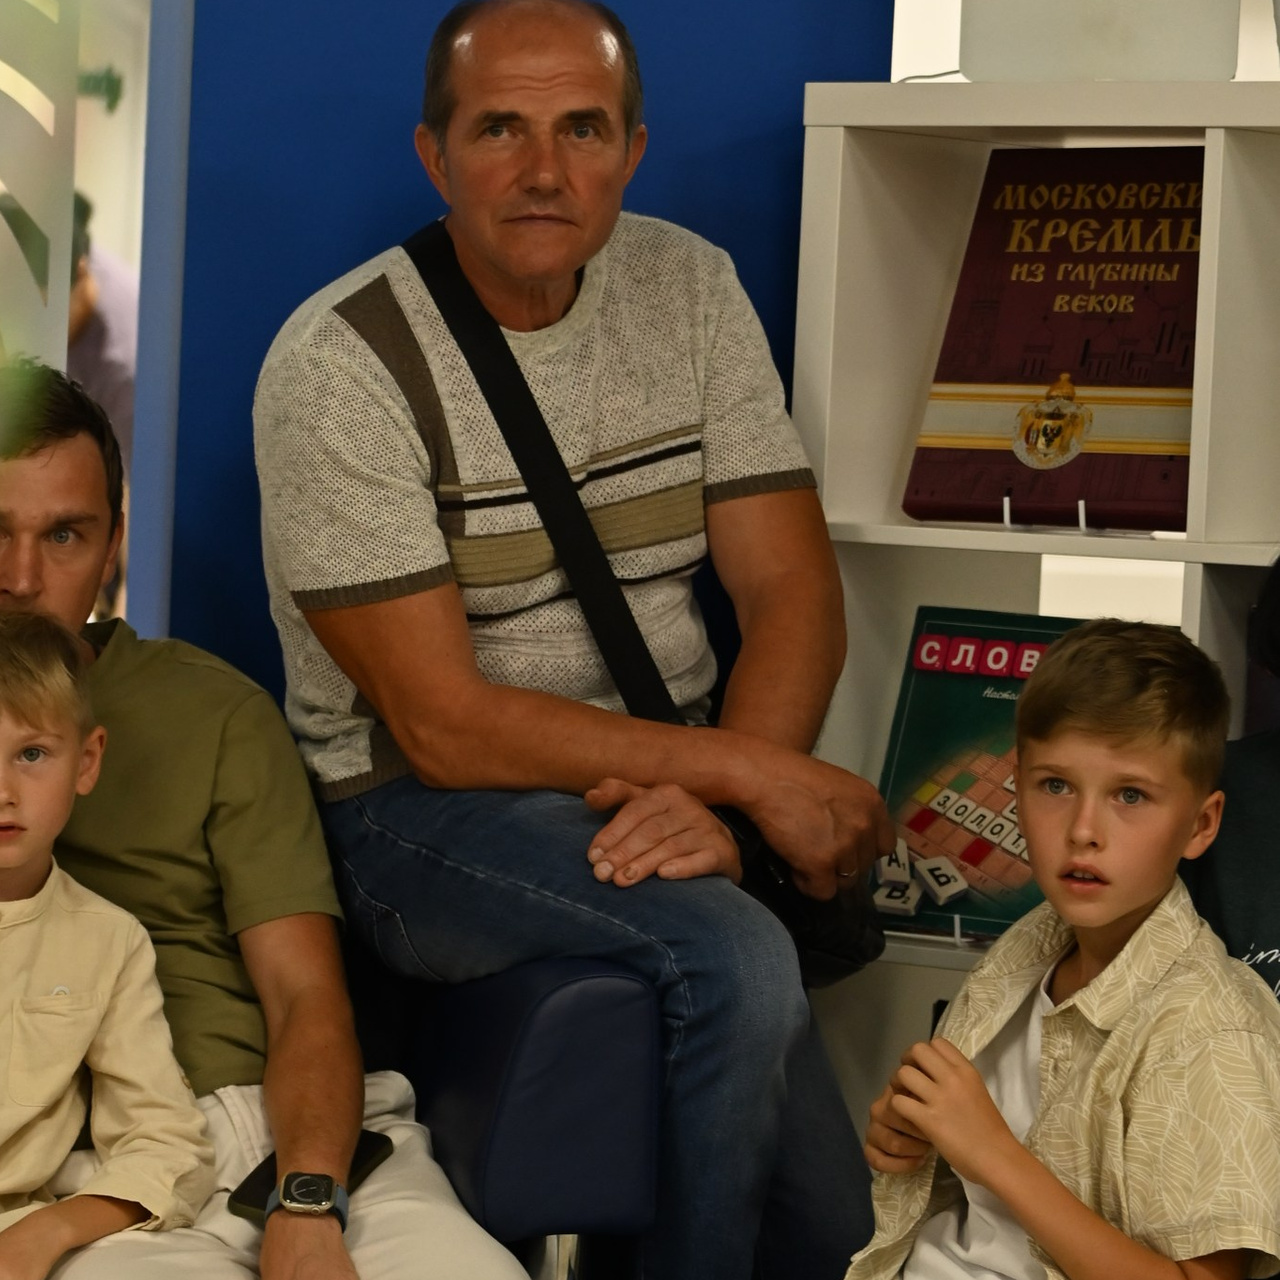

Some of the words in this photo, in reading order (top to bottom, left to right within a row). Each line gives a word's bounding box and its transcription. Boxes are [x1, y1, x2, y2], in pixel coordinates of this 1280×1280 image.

[1005, 218, 1201, 252] КРЕМЛЬ
[1011, 263, 1045, 282] ИЗ
[1057, 263, 1180, 290] ГЛУБИНЫ
[1053, 294, 1135, 313] ВЕКОВ
[937, 795, 1024, 848] ЗОЛОТ
